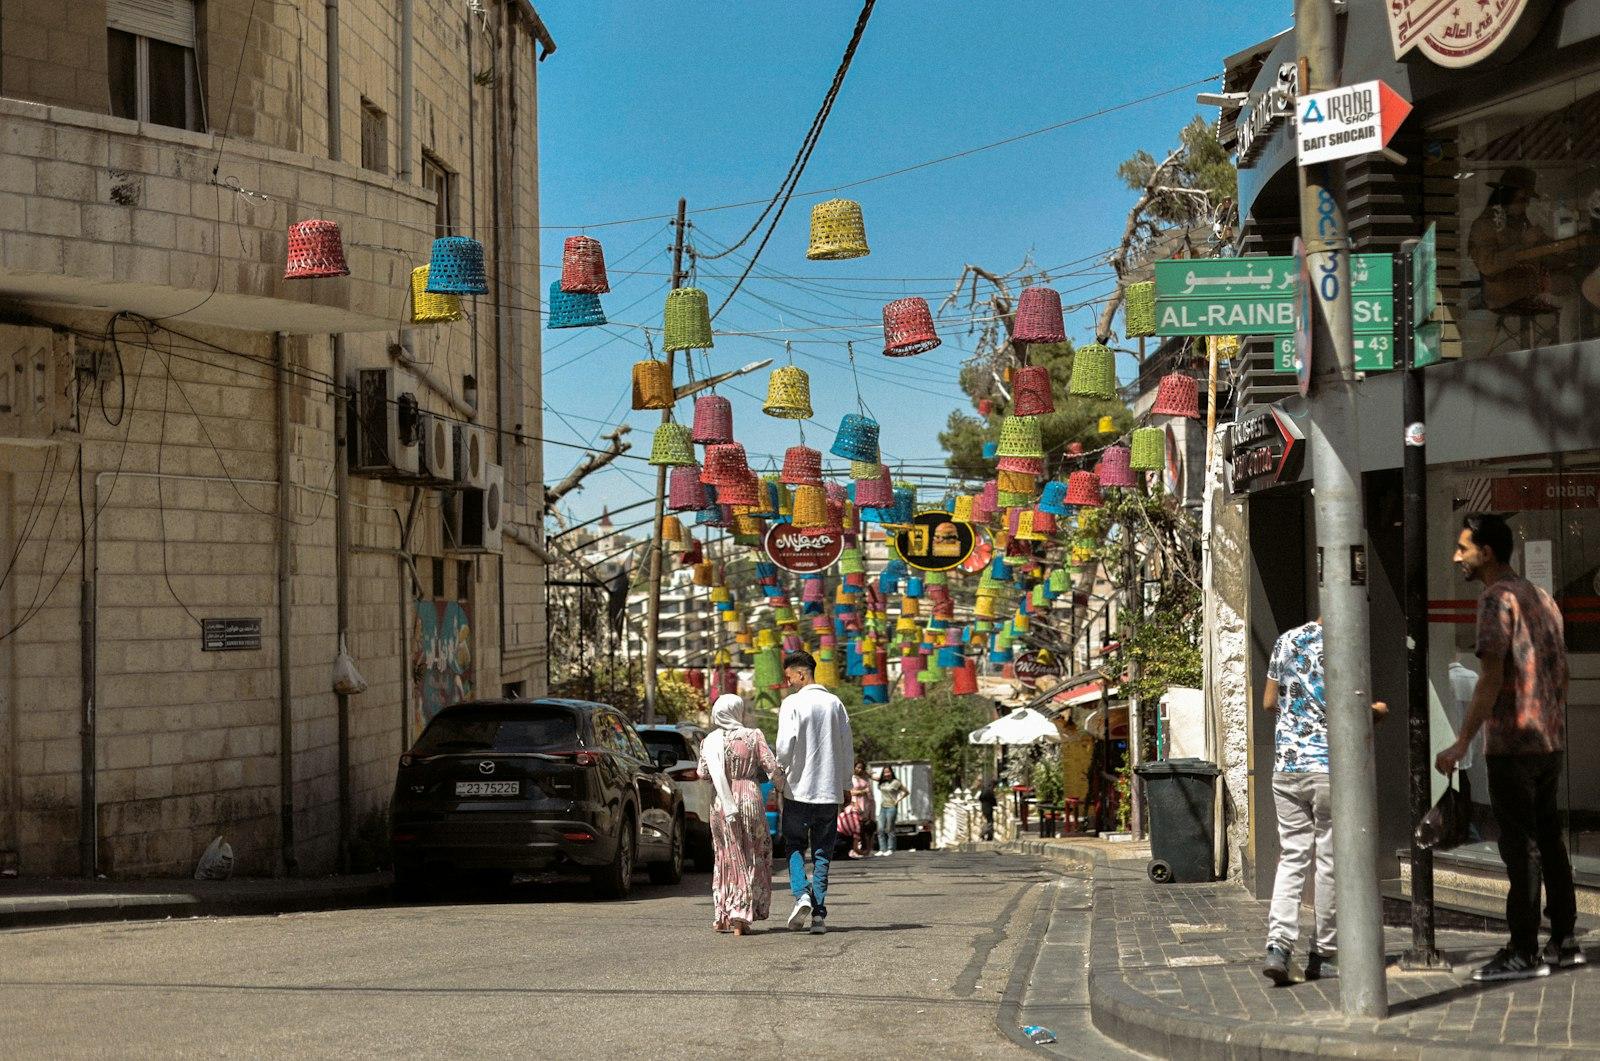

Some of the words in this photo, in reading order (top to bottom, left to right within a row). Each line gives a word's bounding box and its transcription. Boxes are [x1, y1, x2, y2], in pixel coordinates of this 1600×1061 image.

[1442, 22, 1473, 39] العالم
[1345, 112, 1375, 125] SHOP
[1303, 135, 1327, 152] BAIT
[1328, 125, 1376, 147] SHOCAIR
[1353, 300, 1389, 323] St.
[1368, 336, 1389, 351] 43
[1375, 351, 1384, 365] 1
[1546, 485, 1596, 498] ORDER
